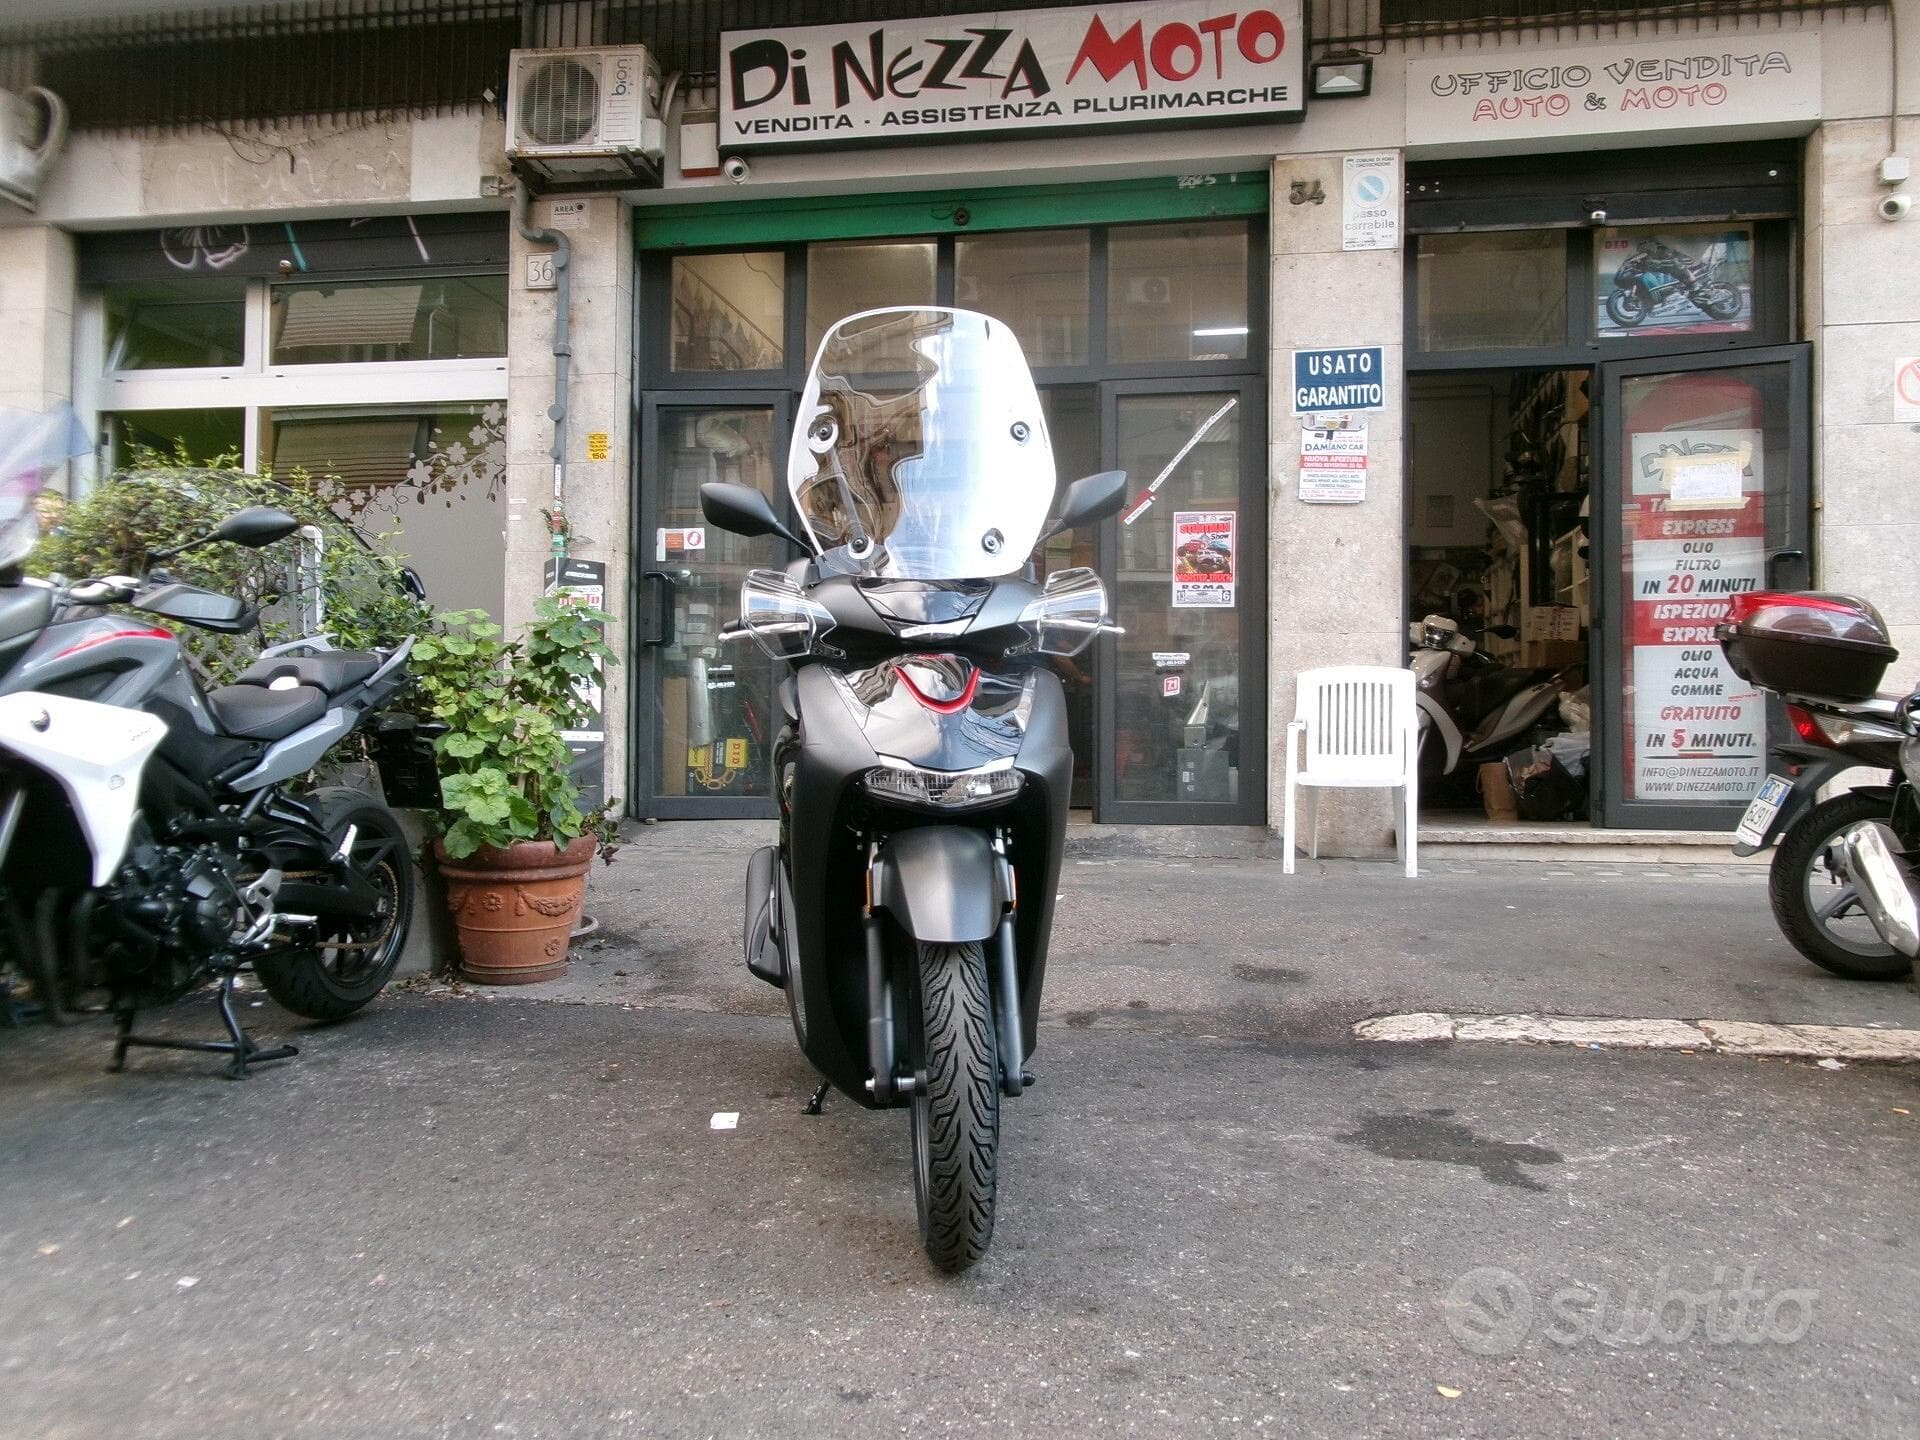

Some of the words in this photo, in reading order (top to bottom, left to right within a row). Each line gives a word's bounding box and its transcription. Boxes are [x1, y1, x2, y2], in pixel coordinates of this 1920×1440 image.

[729, 39, 811, 110] Di
[1065, 10, 1285, 91] MOTO
[1431, 66, 1591, 97] UFFICIO
[1603, 51, 1792, 84] VENDITA
[1473, 94, 1570, 121] AUTO
[1584, 92, 1607, 111] &
[1620, 83, 1728, 111] MOTO
[735, 114, 854, 135] VENDITA
[881, 101, 1062, 127] ASSISTENZA
[1073, 86, 1288, 113] PLURIMARCHE
[1345, 220, 1395, 231] carrabile
[529, 260, 553, 282] 36
[1309, 353, 1371, 376] USATO
[1297, 383, 1382, 407] GARANTITO
[1305, 443, 1347, 451] DAMIANO
[1349, 443, 1364, 451] CAR
[1662, 519, 1736, 535] EXPRESS
[1683, 542, 1714, 553] OLIO
[1675, 559, 1721, 571] FILTRO
[1642, 580, 1661, 594] IN
[1666, 574, 1694, 593] 20
[1698, 578, 1756, 593] MINUTI
[1653, 603, 1731, 619] ISPEZION
[1663, 626, 1720, 642] EXPRE
[1681, 650, 1712, 662] OLIO
[1674, 667, 1719, 679] ACQUA
[1671, 684, 1723, 696] GOMME
[1660, 706, 1741, 721] GRATUITO
[1646, 734, 1665, 748] IN
[1671, 729, 1686, 748] 5
[1691, 733, 1757, 748] MINUTI.
[1642, 767, 1760, 778] INFO@DINEZZAMOTO.IT
[1645, 781, 1756, 792] WWW.DINEZZAMOTO.IT
